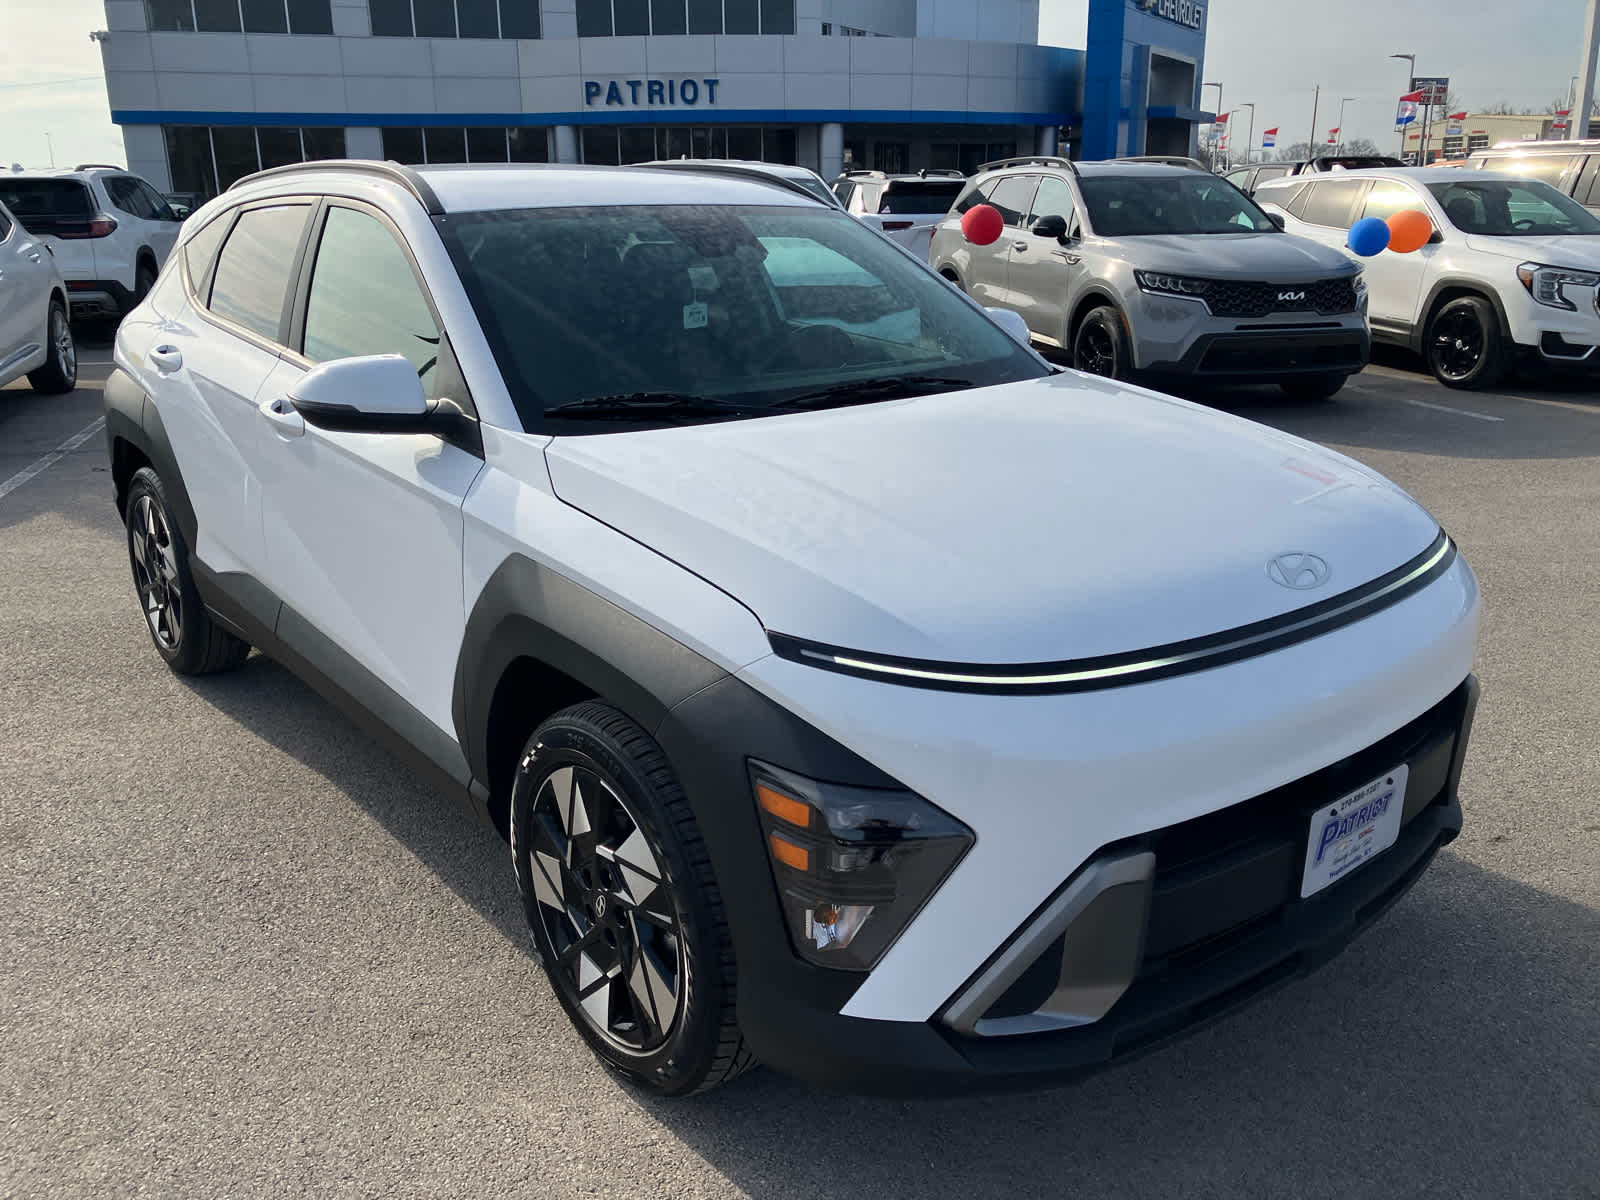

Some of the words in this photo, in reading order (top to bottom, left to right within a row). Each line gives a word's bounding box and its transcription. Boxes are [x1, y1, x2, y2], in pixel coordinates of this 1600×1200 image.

[1158, 0, 1203, 29] CHEVROLET
[584, 78, 720, 105] PATRIOT
[1315, 792, 1393, 862] PATRIOT
